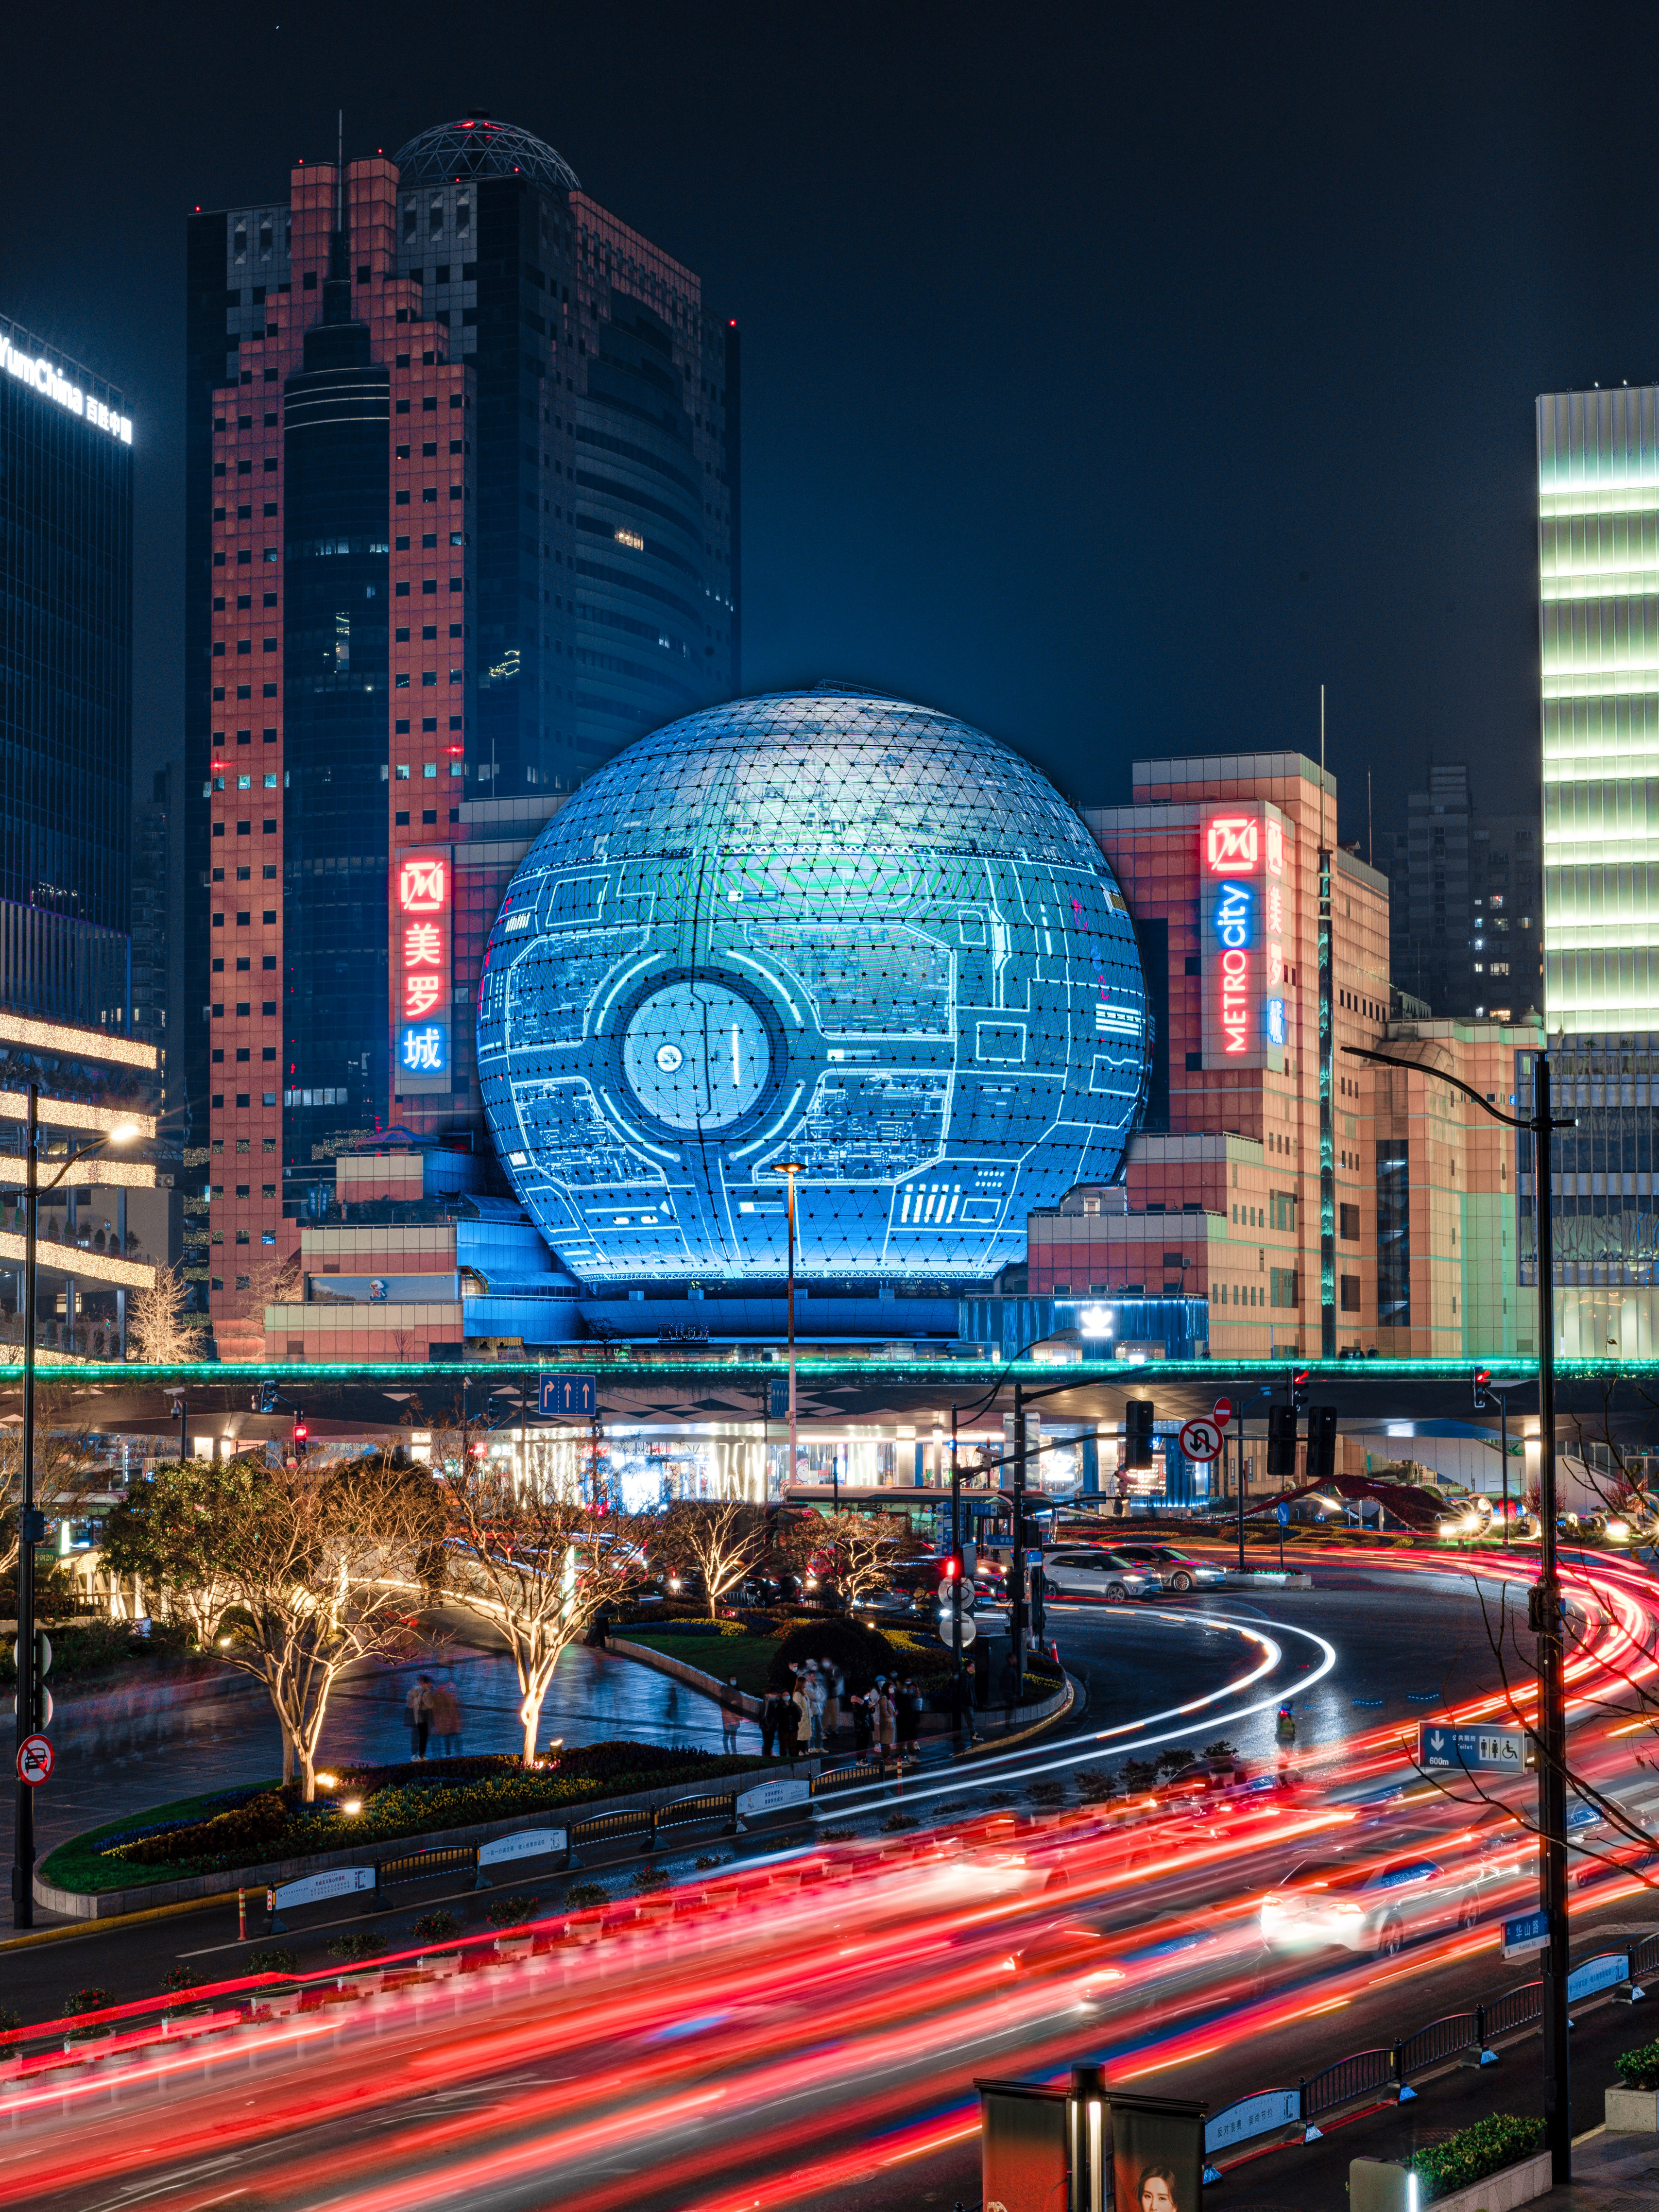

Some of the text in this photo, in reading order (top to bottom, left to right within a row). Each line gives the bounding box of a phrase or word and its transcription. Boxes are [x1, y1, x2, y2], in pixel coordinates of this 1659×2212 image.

[86, 395, 132, 445] 百胜中国
[404, 923, 442, 1070] 美罗城
[1429, 1757, 1449, 1766] 600m
[1516, 1919, 1539, 1939] 华山路
[1217, 2119, 1242, 2138] 反对浪费
[1249, 2108, 1272, 2126] 崇尚节约
